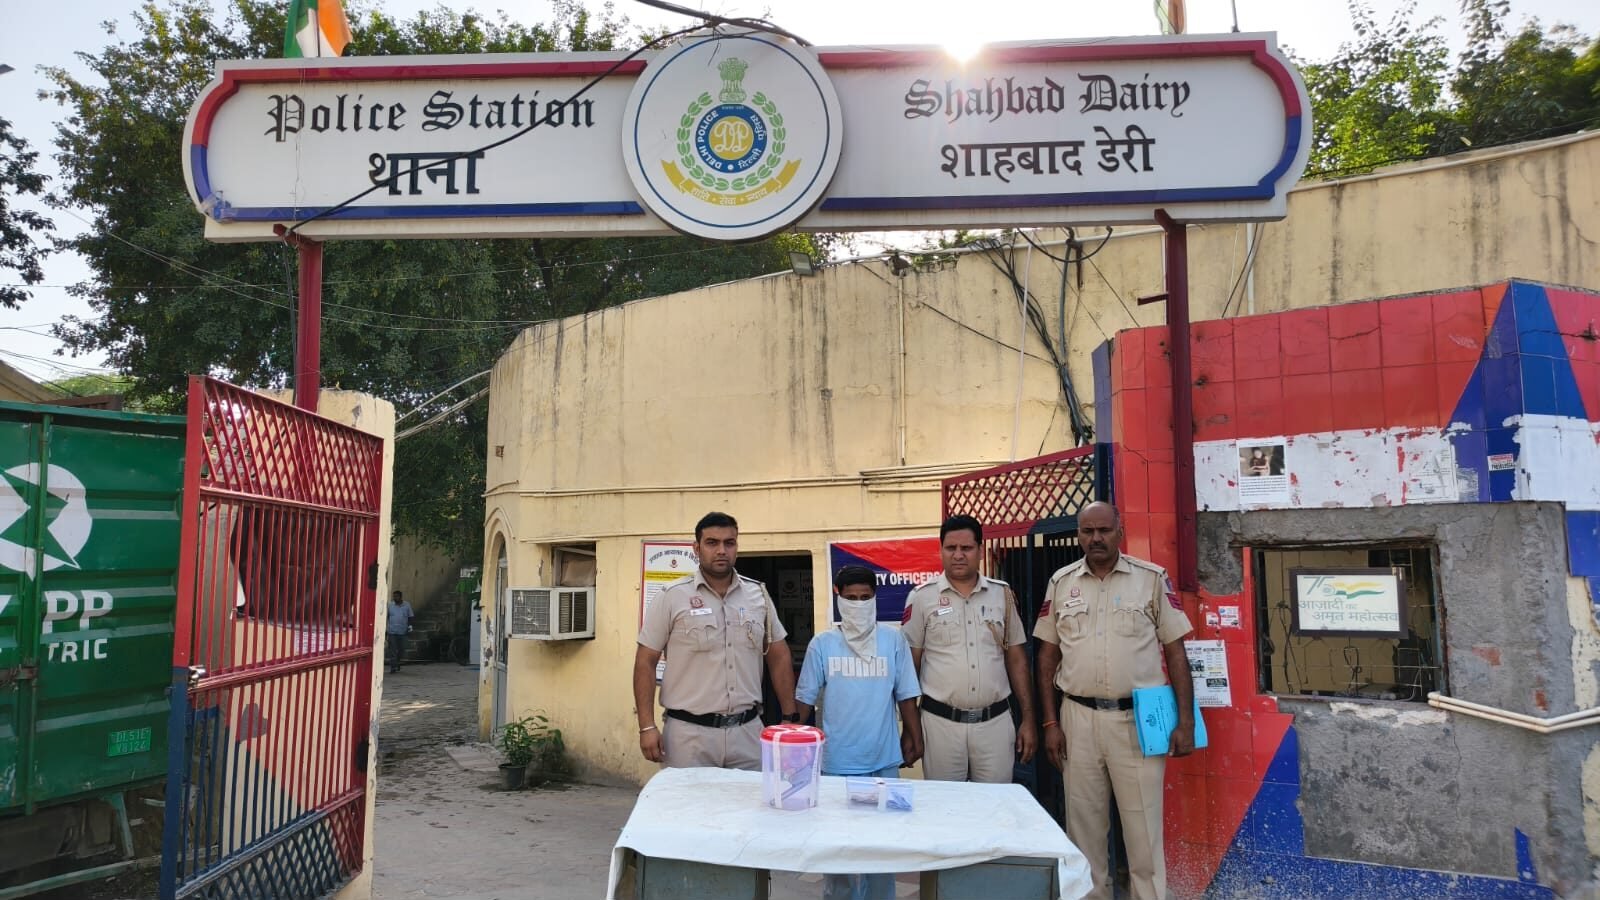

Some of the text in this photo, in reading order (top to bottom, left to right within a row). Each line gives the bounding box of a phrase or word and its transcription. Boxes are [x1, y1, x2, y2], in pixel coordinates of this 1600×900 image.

[264, 90, 596, 143] Police Station
[904, 73, 1191, 123] Shahbad Dairy
[697, 110, 722, 169] DELHI POLICE
[940, 125, 1157, 183] शाहबाद डेरी
[368, 151, 485, 196] थाना
[875, 573, 887, 586] TY
[828, 656, 888, 677] PUMA
